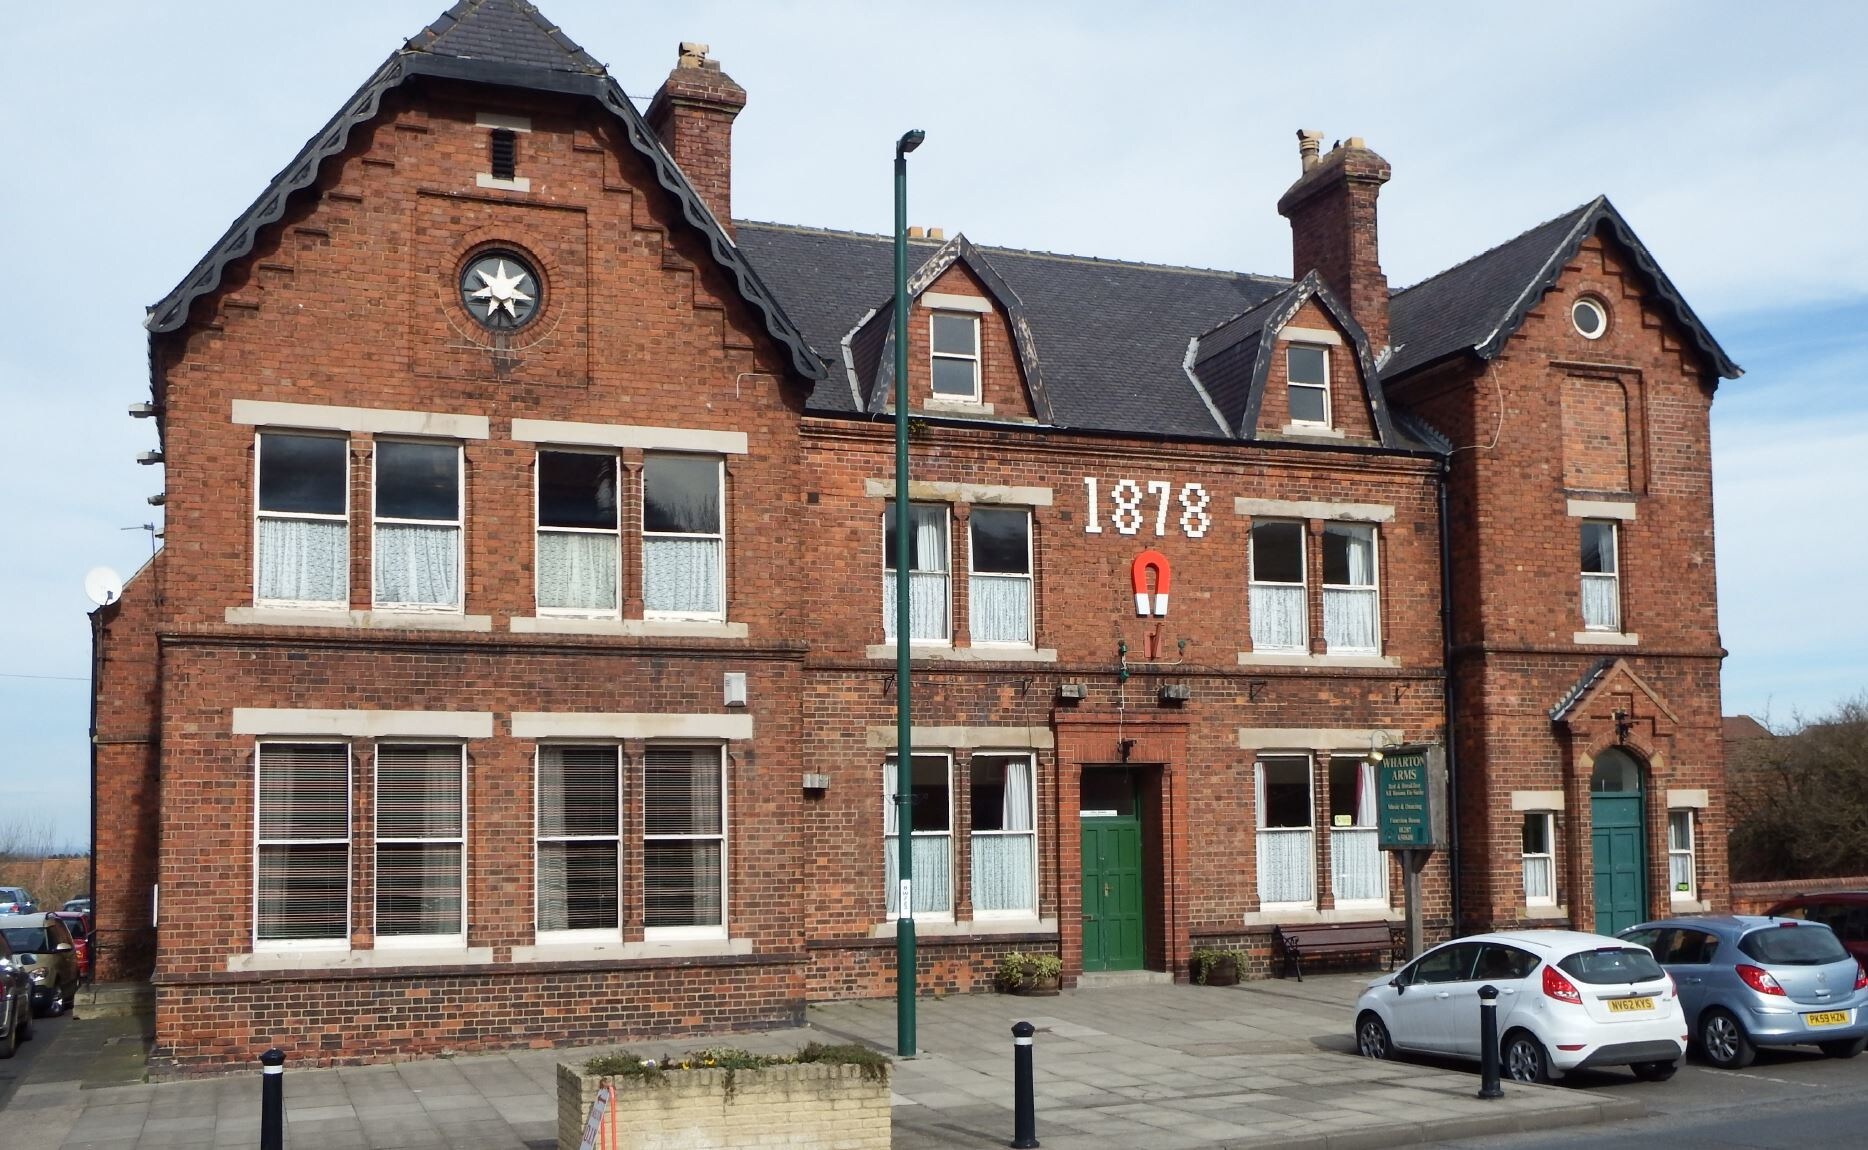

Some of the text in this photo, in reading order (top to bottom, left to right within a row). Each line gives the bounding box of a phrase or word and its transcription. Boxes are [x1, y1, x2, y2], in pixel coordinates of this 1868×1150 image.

[1084, 477, 1210, 537] 1878
[1382, 756, 1424, 768] WHARTON
[1392, 770, 1417, 780] ARMS
[1611, 999, 1652, 1011] NV62 KYS
[1809, 1012, 1846, 1023] PK59 HZN
